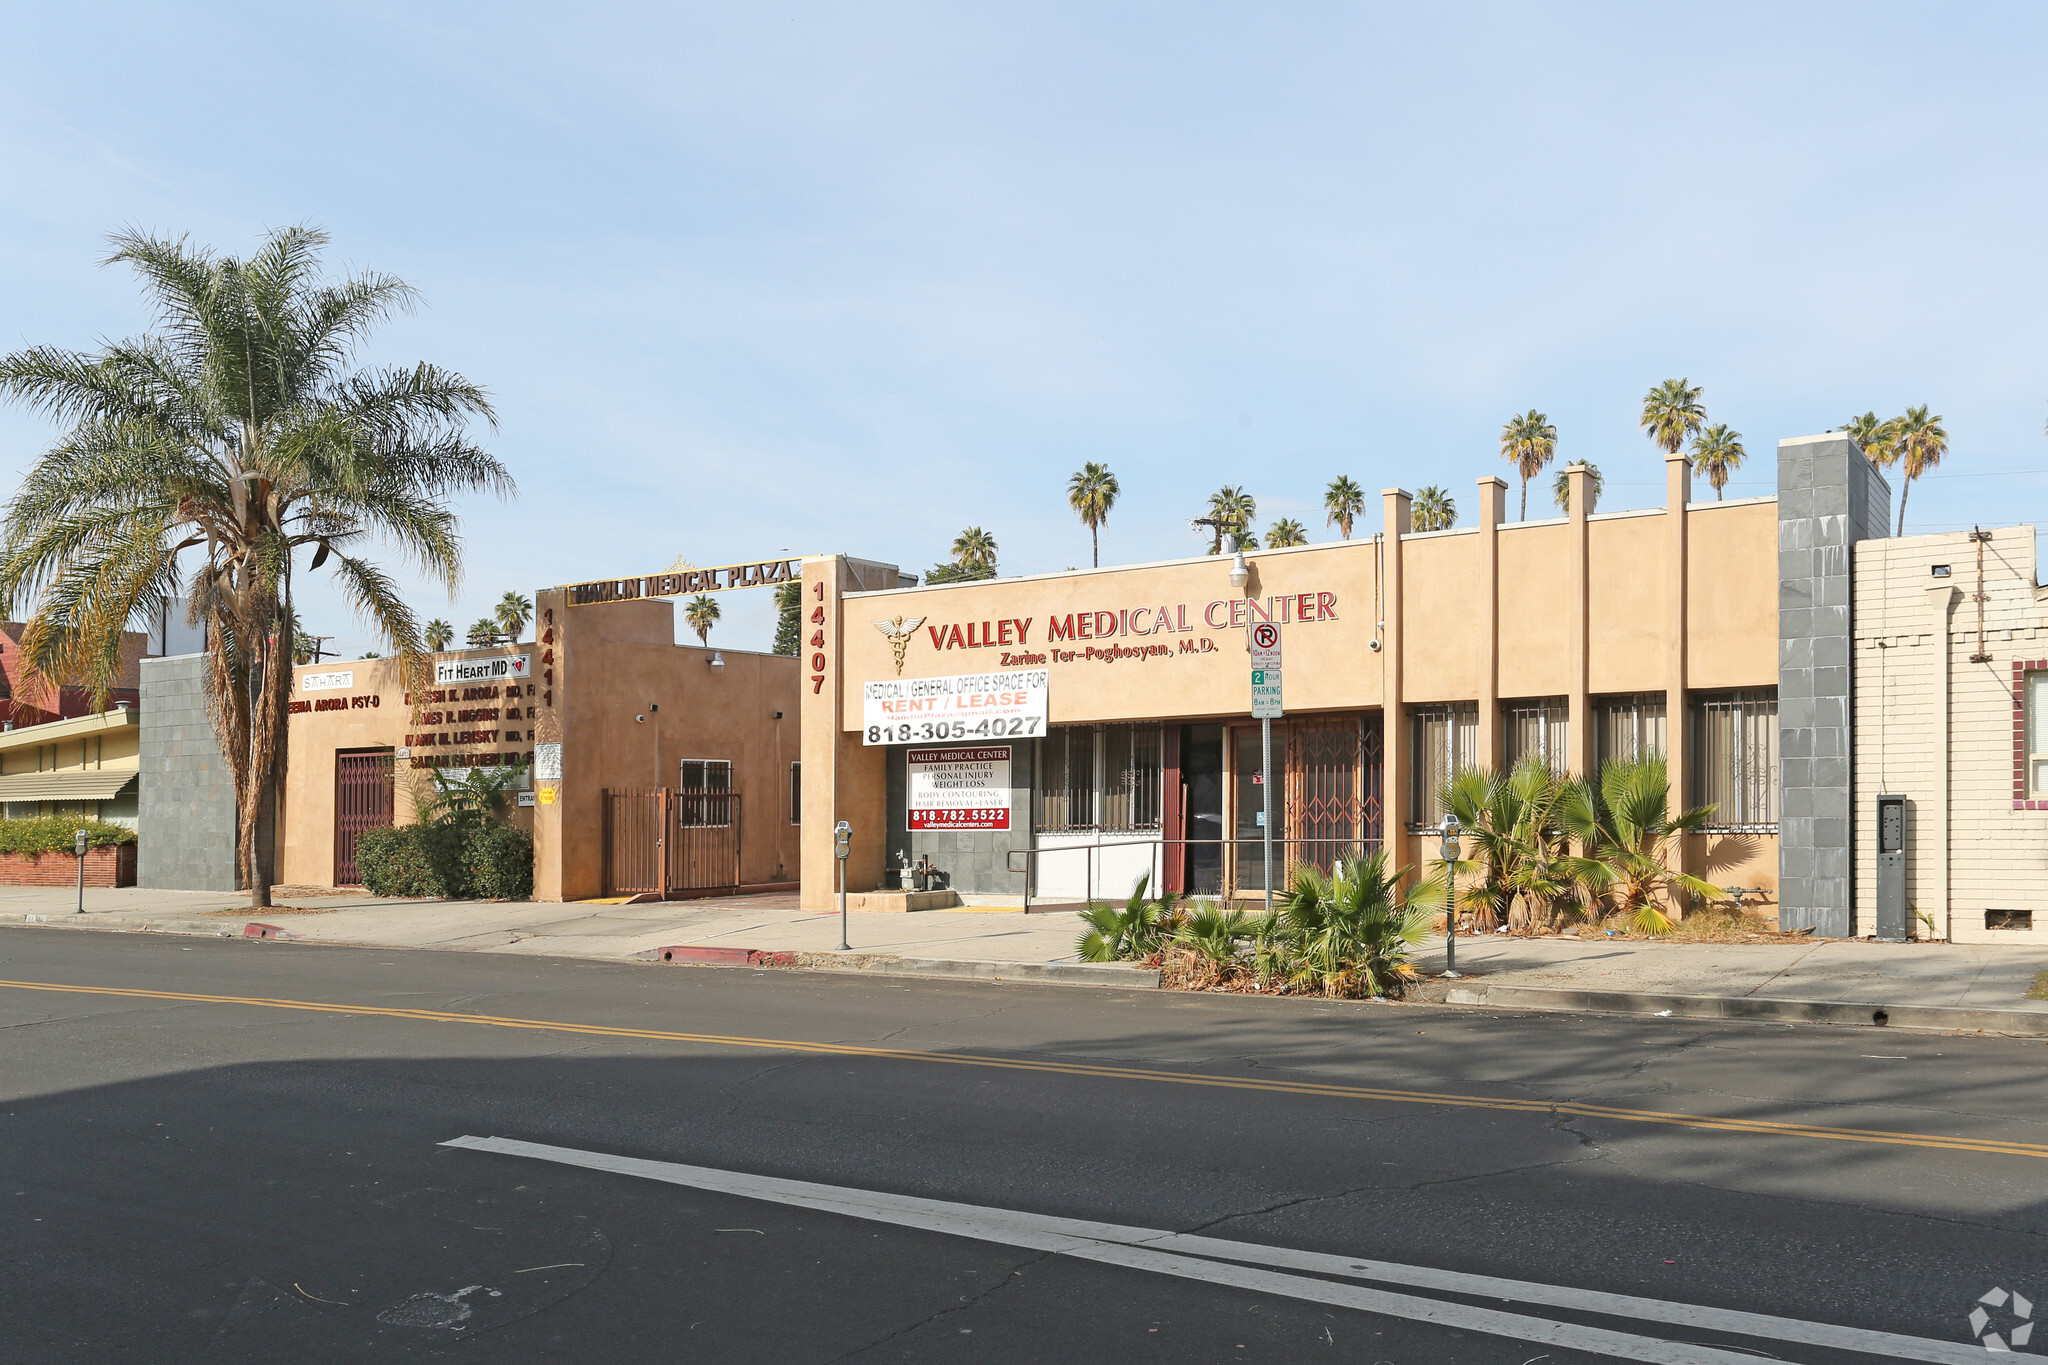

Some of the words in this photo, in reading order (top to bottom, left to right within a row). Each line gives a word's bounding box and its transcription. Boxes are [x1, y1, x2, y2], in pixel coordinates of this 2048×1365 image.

[576, 579, 640, 604] HAMLIN
[645, 569, 721, 597] MEDICAL
[728, 561, 791, 588] PLAZA
[928, 617, 1033, 651] VALLEY
[1048, 604, 1193, 642] MEDICAL
[1203, 592, 1339, 630] CENTER
[810, 582, 825, 695] 14407
[542, 608, 554, 707] 14411
[1000, 650, 1046, 667] Zarine
[1050, 643, 1174, 664] Ter-Poghosyan,
[1178, 638, 1219, 655] M.D.
[438, 666, 453, 681] FIT
[456, 664, 490, 679] HEART
[492, 660, 508, 675] MD
[1254, 672, 1261, 683] 2
[1265, 673, 1280, 681] HOUR
[866, 683, 904, 700] MEDICAL
[911, 679, 953, 698] GENERAL
[957, 676, 989, 694] OFFICE
[992, 673, 1023, 692] SPACE
[1026, 671, 1046, 689] FOR
[1253, 685, 1281, 696] PARKING
[462, 686, 499, 701] ARORA
[314, 697, 349, 712] ARORA
[351, 695, 380, 709] PSY-D
[882, 697, 938, 714] RENT
[957, 691, 1028, 709] LEASE
[458, 708, 500, 723] HIGGINS
[868, 716, 1041, 743] 818-305-4027
[454, 730, 499, 745] LENSKY
[911, 752, 938, 761] VALLEY
[940, 751, 975, 760] MEDICAL
[977, 750, 1008, 759] CENTER
[924, 763, 952, 772] FAMILY
[954, 762, 993, 771] PRACTICE
[923, 771, 963, 780] PERSONAL
[965, 771, 994, 779] INJURY
[932, 780, 963, 789] WEIGHT
[965, 779, 985, 788] LOSS
[918, 791, 940, 799] BODY
[942, 790, 999, 799] CONTOURING
[915, 800, 934, 808] HAIR
[913, 809, 1005, 821] 818.782.5522
[923, 820, 994, 829] valleymedicalcenters.com
